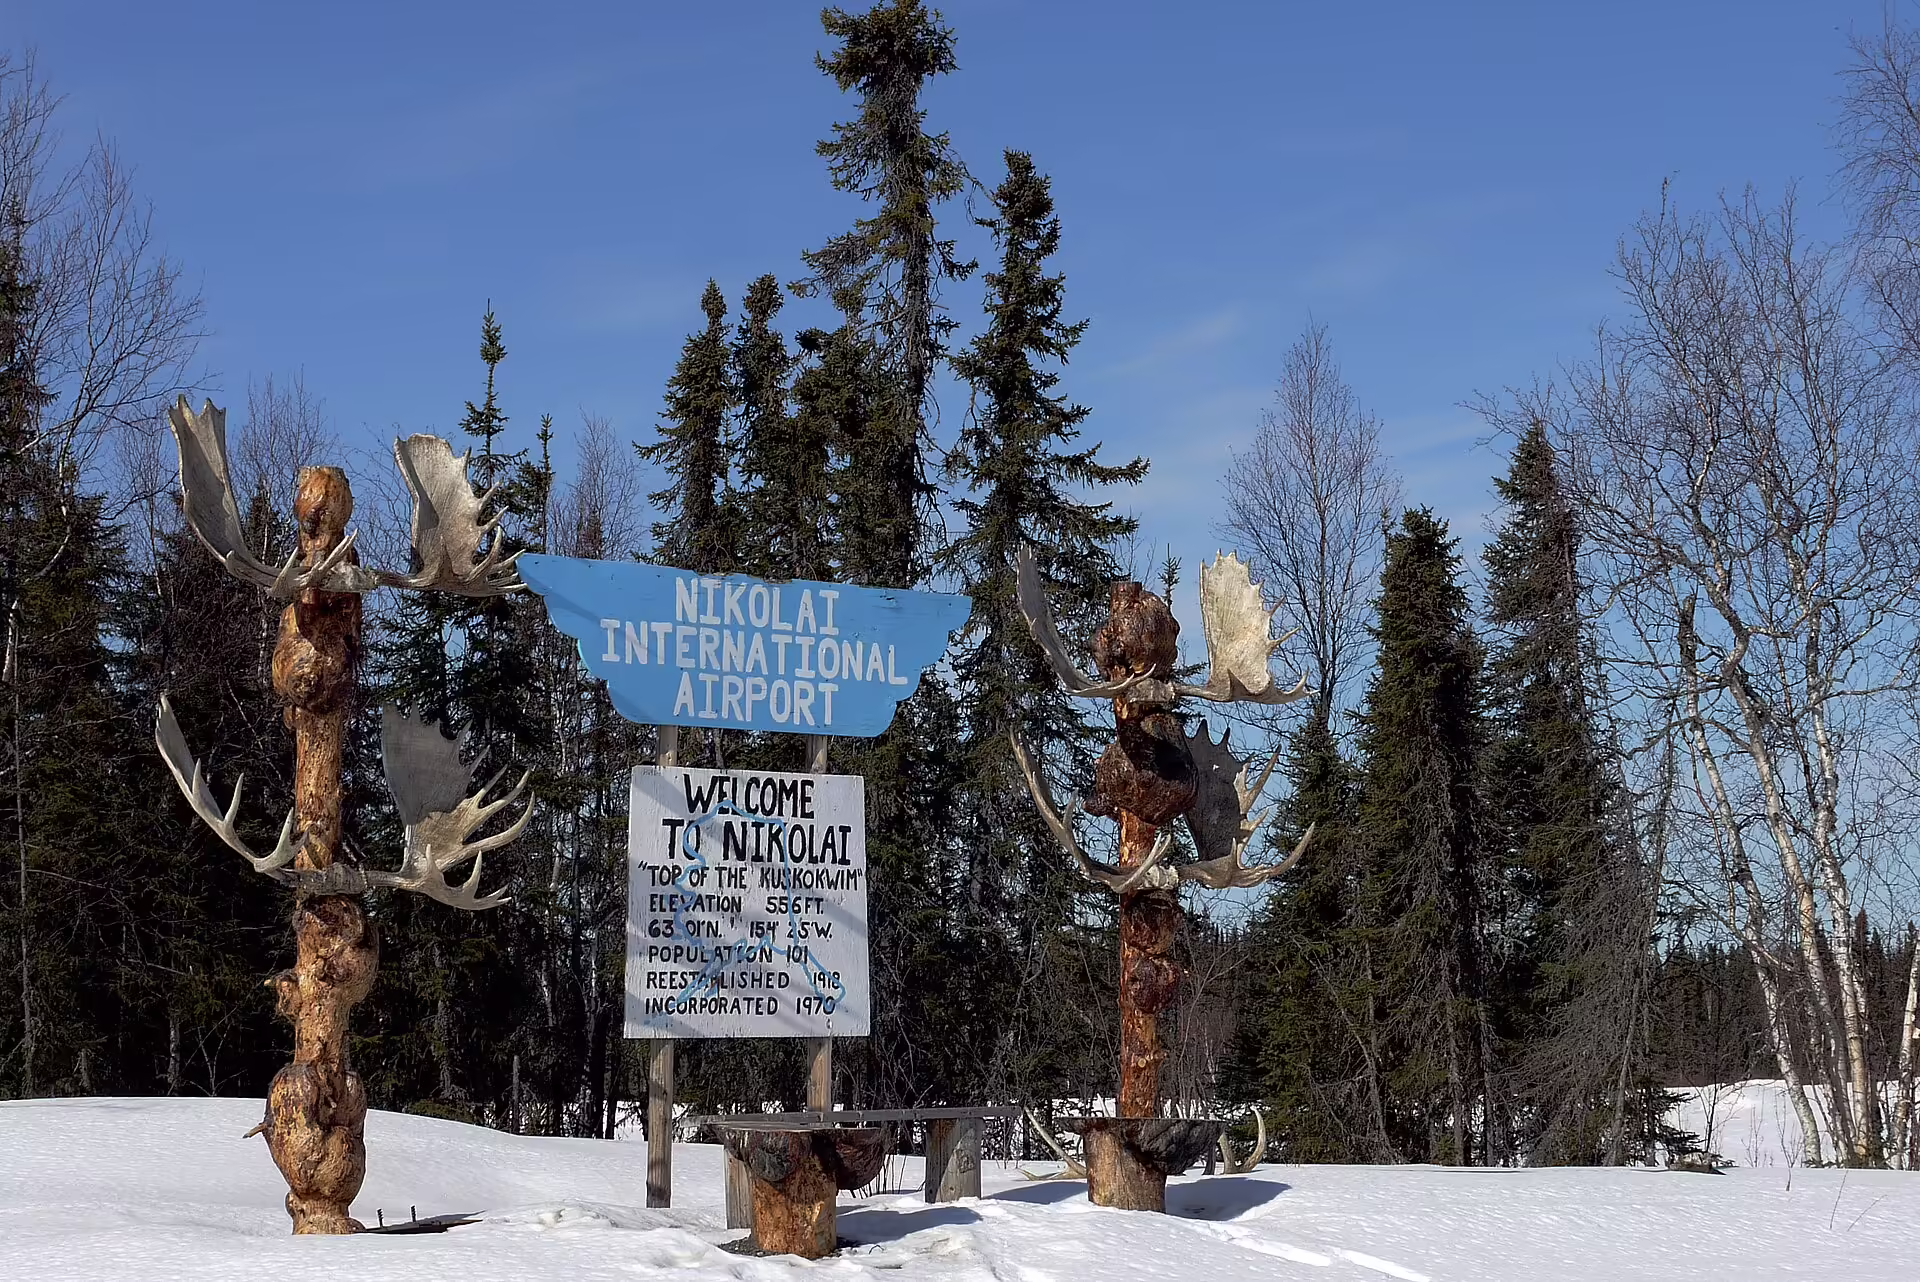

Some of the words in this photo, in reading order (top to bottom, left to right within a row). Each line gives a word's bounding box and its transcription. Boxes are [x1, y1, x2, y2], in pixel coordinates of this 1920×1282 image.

[674, 576, 839, 635] NIKOLAI
[600, 618, 908, 685] INTERNATIONAL
[672, 671, 839, 725] AIRPORT
[682, 773, 815, 819] WELCOME
[662, 818, 701, 860] TO
[722, 821, 852, 866] NIKOLAI
[688, 866, 709, 888] OF
[714, 866, 748, 889] THE
[649, 893, 742, 913] ELEVATION
[648, 945, 773, 963] POPULATION
[786, 945, 808, 964] 101
[813, 971, 841, 990] 1918
[645, 996, 779, 1016] INCORPORATED
[796, 996, 836, 1016] 1970
